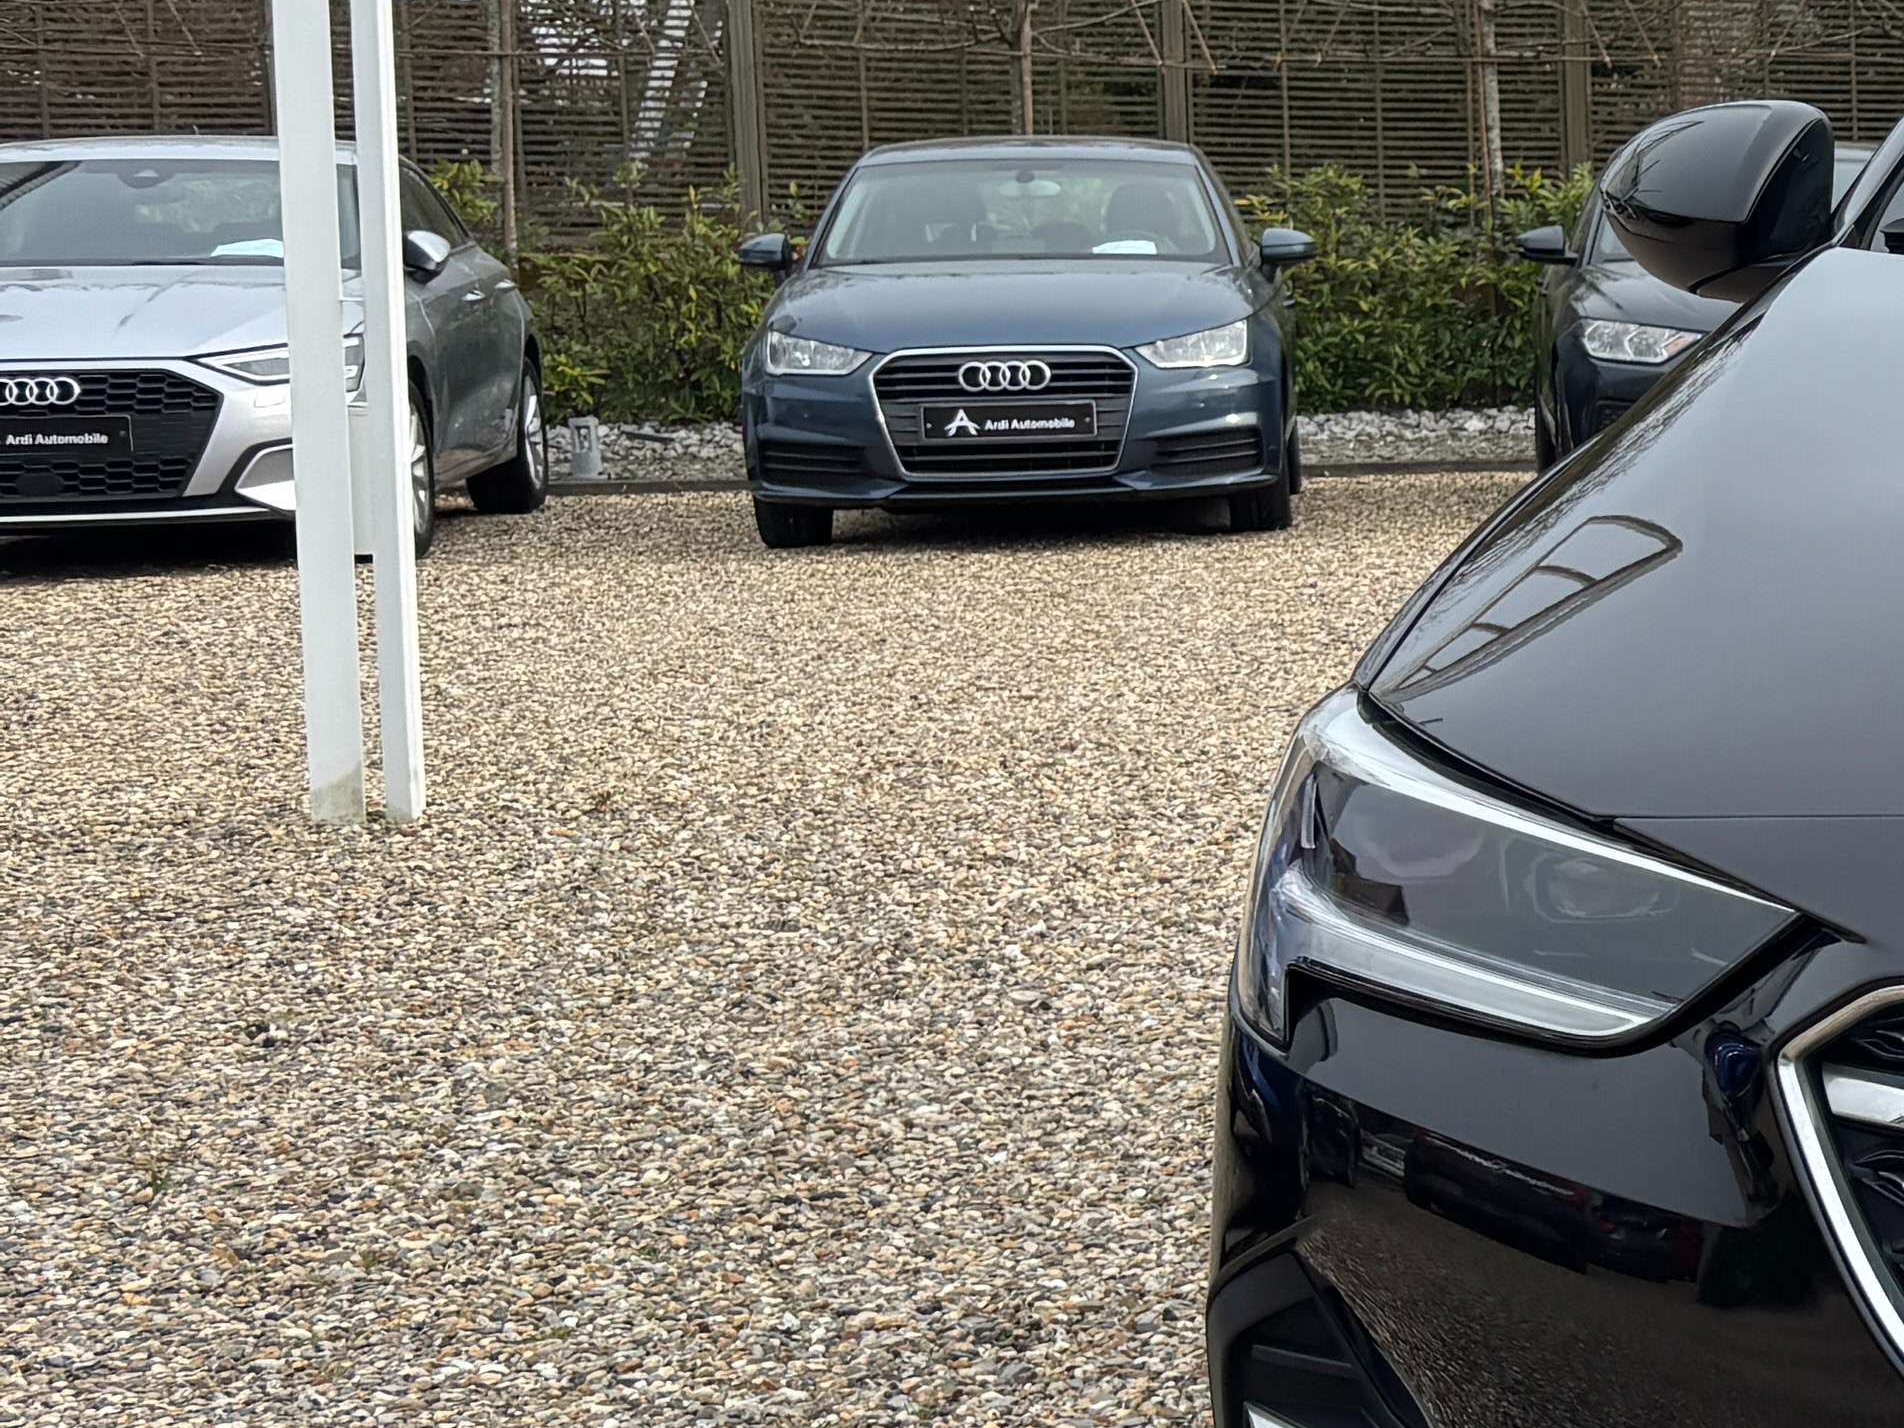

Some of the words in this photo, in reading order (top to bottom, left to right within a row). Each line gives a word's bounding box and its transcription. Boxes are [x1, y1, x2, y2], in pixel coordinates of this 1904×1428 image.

[984, 418, 1009, 431] Ardi
[1011, 418, 1076, 430] Automobile
[5, 434, 33, 445] Ardi
[35, 432, 109, 445] Automobile
